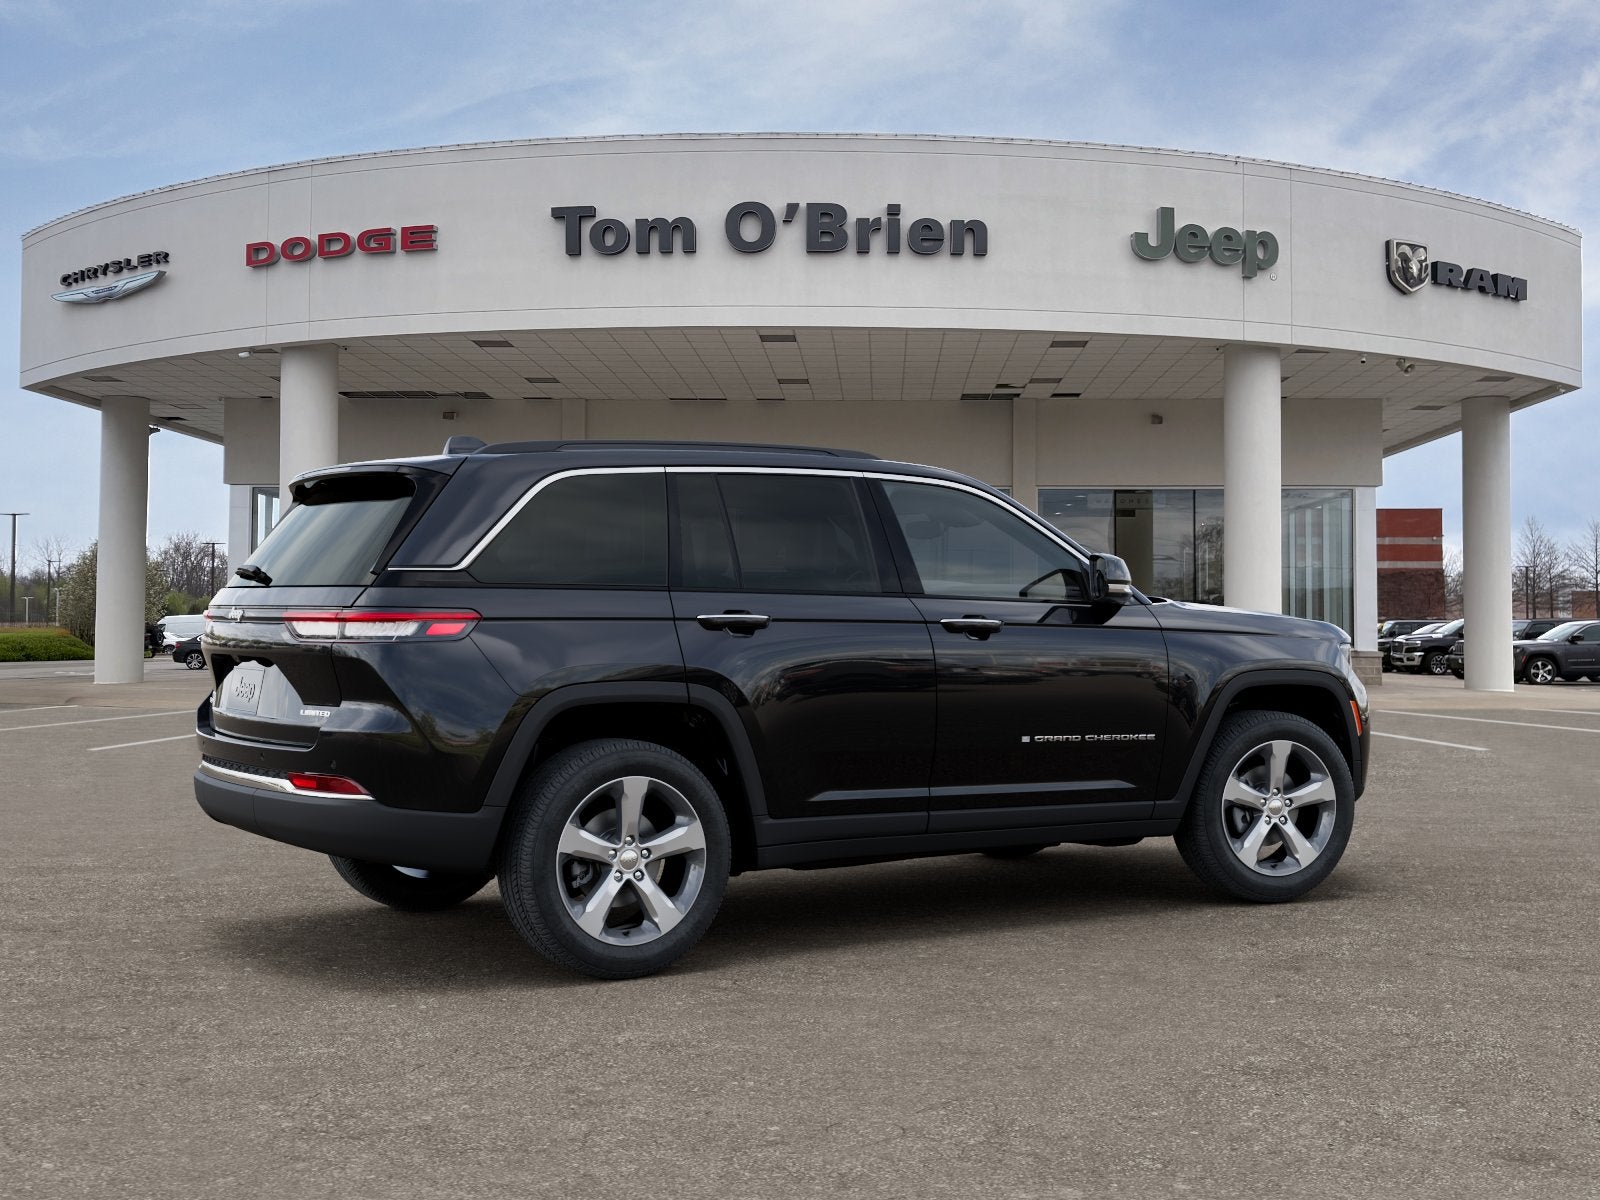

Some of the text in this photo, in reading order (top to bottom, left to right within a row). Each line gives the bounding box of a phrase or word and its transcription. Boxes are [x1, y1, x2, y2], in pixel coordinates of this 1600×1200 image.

[245, 224, 439, 269] DODGE
[551, 201, 989, 257] Tom O'Brien
[1130, 206, 1279, 279] Jeep
[60, 250, 170, 287] CHRYSLER
[1430, 261, 1528, 302] RAM
[300, 709, 331, 717] LIMITED
